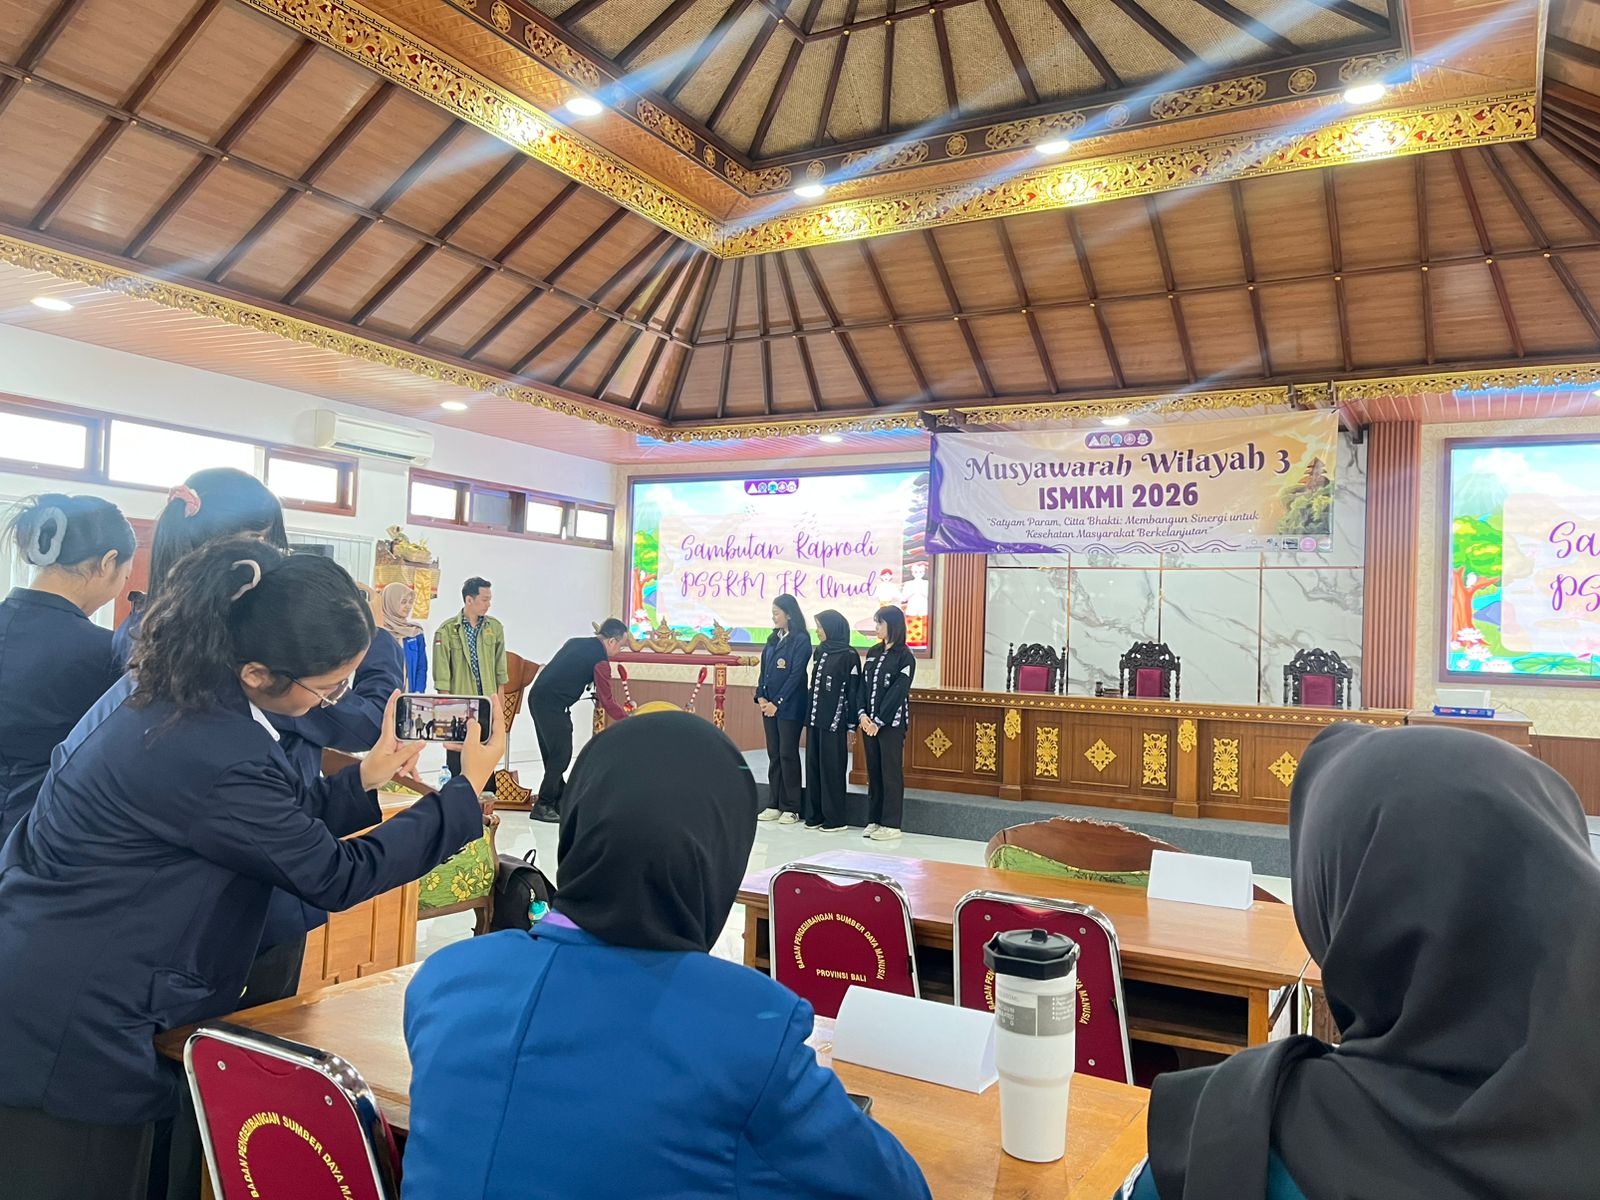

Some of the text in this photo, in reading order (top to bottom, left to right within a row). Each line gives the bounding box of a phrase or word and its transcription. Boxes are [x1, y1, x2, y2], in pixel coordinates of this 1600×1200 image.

[964, 443, 1291, 486] Musyawarah Wilayah 3
[1039, 482, 1199, 510] ISMKMI 2026
[1026, 529, 1074, 539] Kesehatan
[1076, 527, 1134, 541] Masyarakat
[1063, 517, 1085, 526] Citta
[1124, 514, 1188, 528] Membangun
[1190, 512, 1228, 524] Sinergi
[1229, 511, 1259, 522] untuk
[680, 530, 880, 567] Sambutan Kaprodi
[680, 570, 766, 600] PSSKM
[815, 570, 878, 599] Unud
[793, 912, 886, 981] BADAN PENGEMBANGAN SUMBER DAYA MANUSIA
[816, 968, 867, 983] PROVINSI BALI
[1078, 990, 1092, 1025] MANUSIA
[237, 1111, 281, 1160] PENGEMBANGAN
[282, 1115, 323, 1156] SUMBER
[239, 1158, 260, 1198] BADAN
[322, 1152, 344, 1183] DAYA
